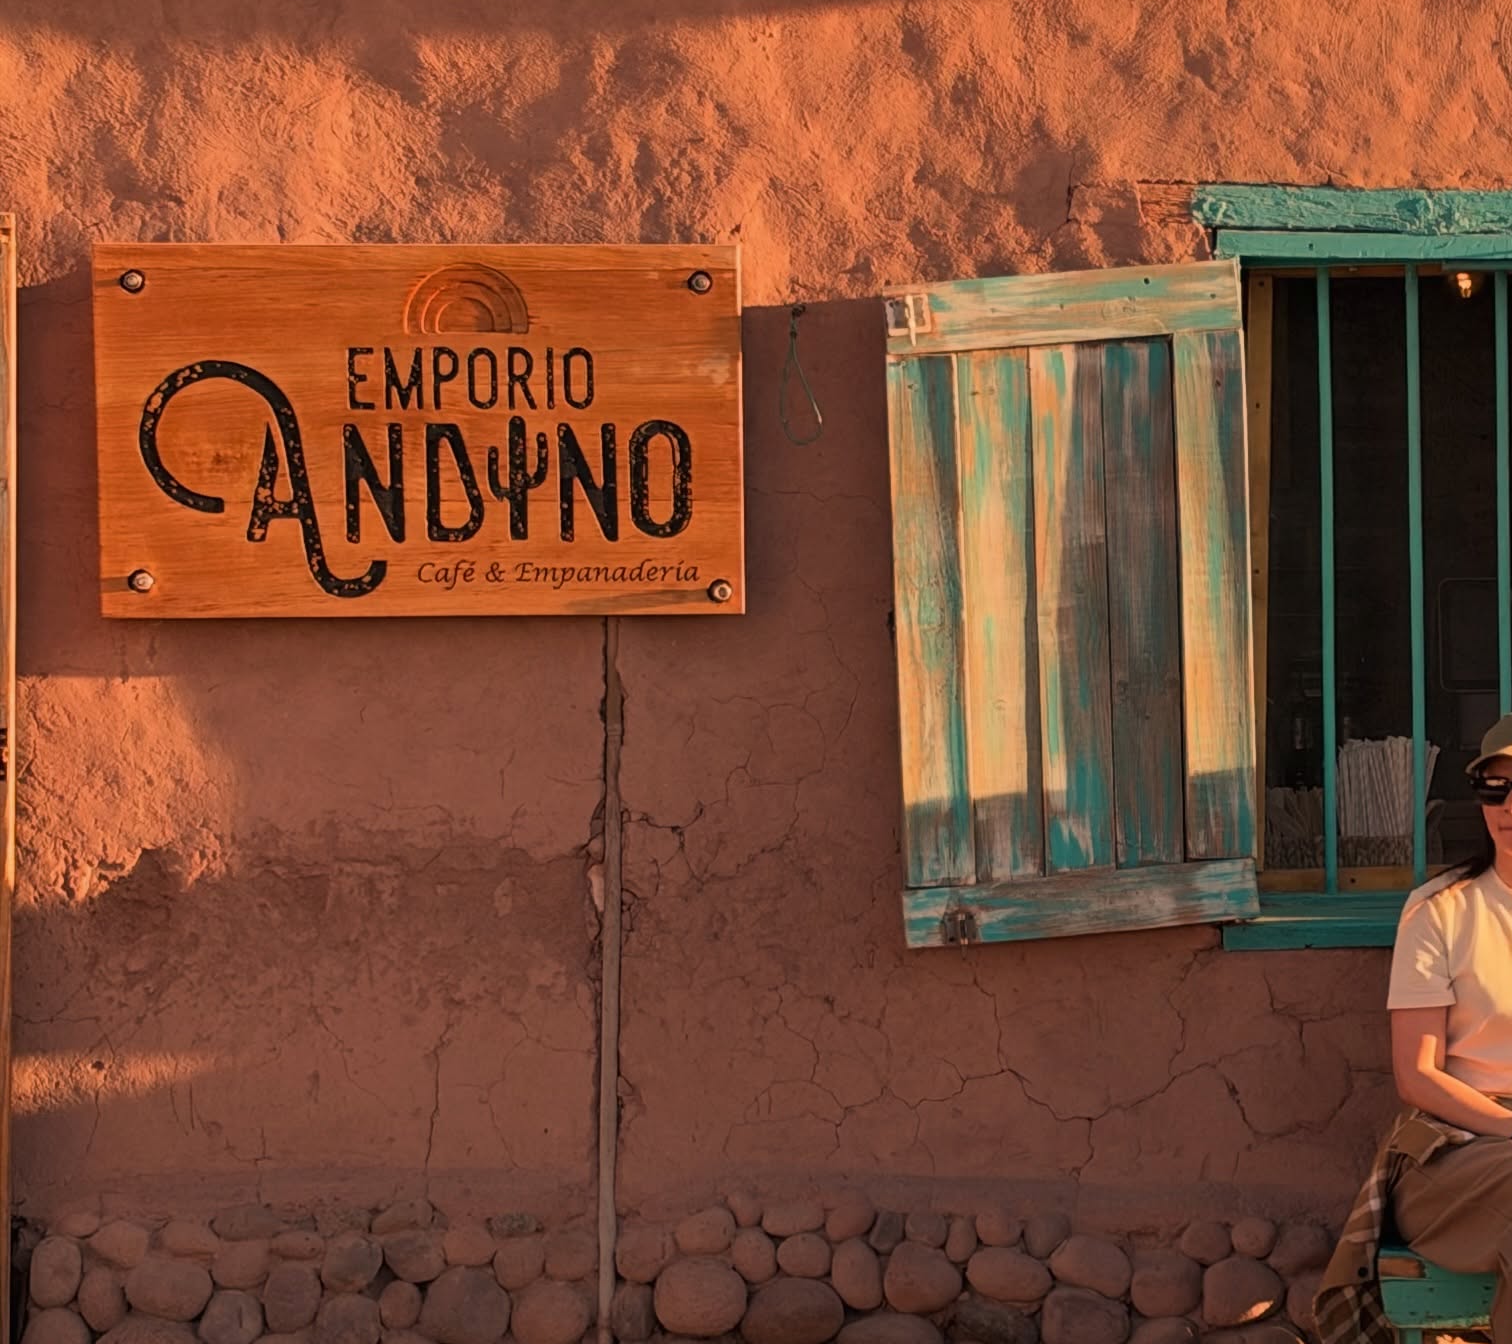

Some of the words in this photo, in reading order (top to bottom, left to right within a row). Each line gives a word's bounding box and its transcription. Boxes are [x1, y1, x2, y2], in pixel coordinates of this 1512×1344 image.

[345, 346, 595, 411] EMPORIO
[416, 559, 476, 591] Café
[484, 561, 505, 583] &
[514, 558, 701, 591] Empanadería
